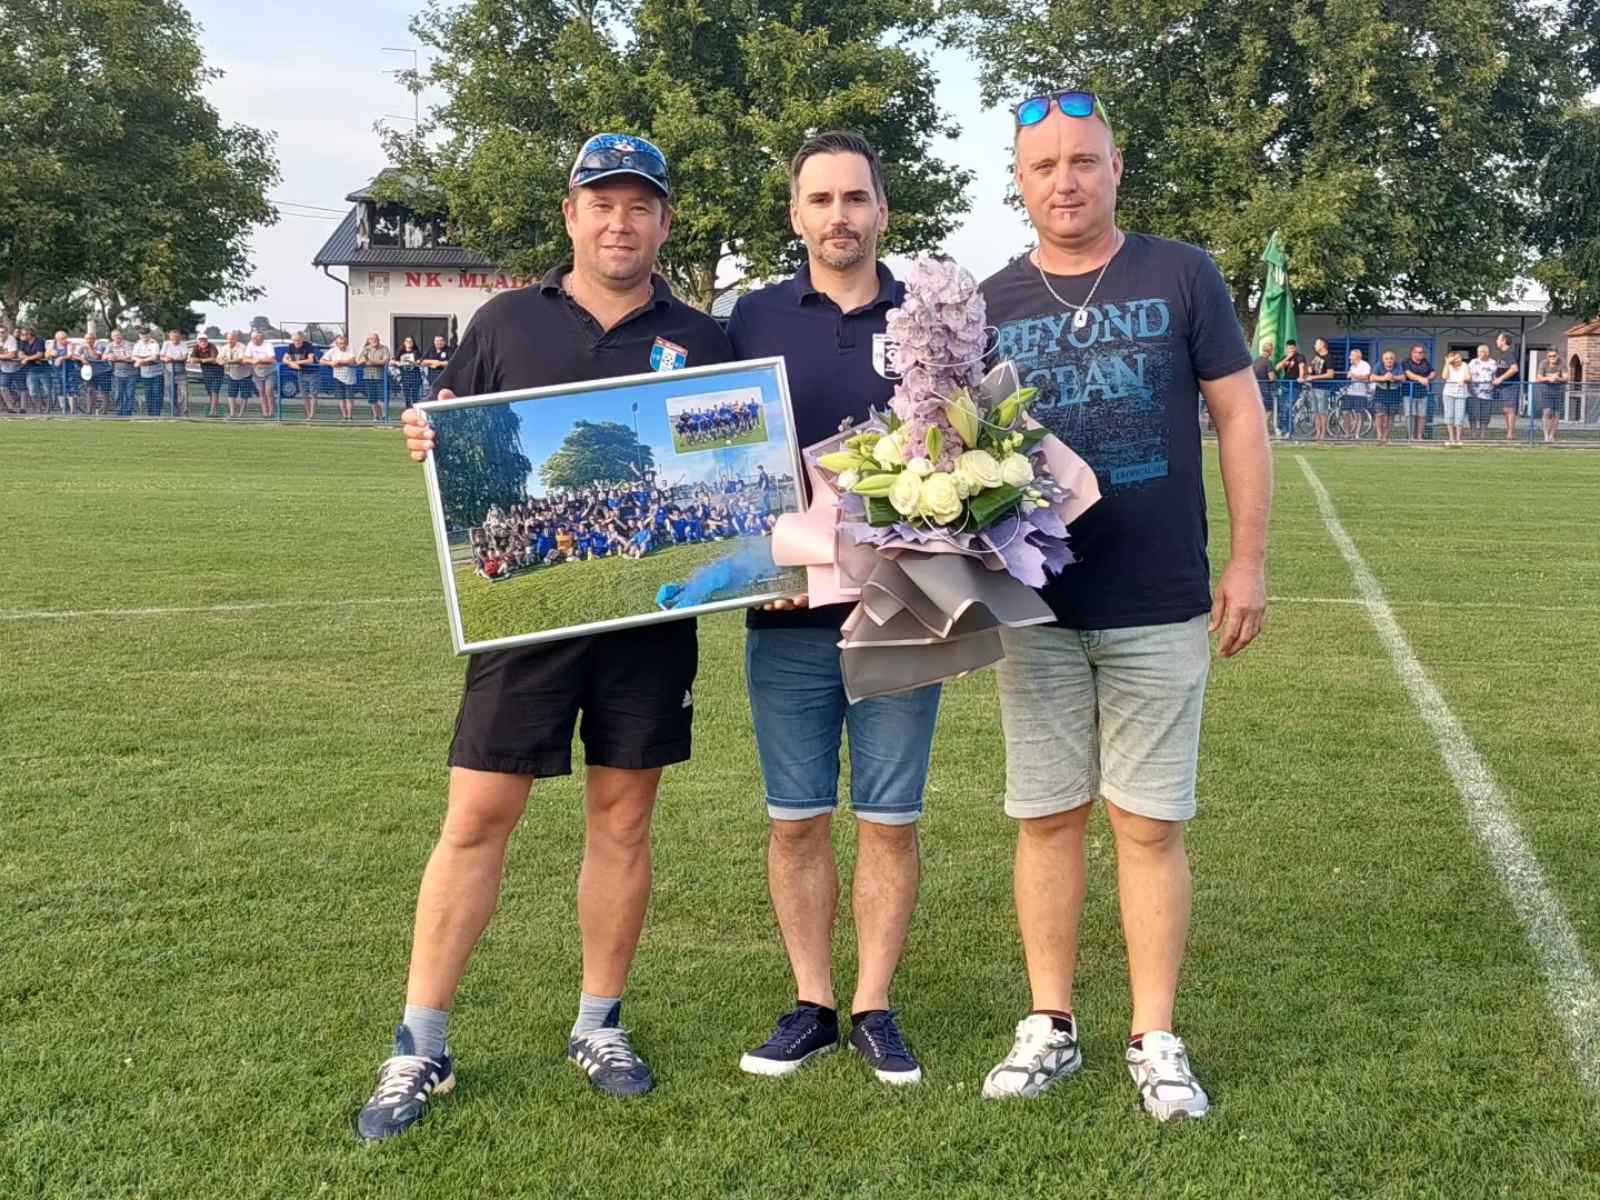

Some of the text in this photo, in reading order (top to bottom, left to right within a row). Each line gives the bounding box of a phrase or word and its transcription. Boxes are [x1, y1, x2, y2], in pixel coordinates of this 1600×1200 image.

[404, 272, 443, 288] NK
[998, 299, 1170, 359] BEYOND
[1022, 352, 1149, 409] CEAN
